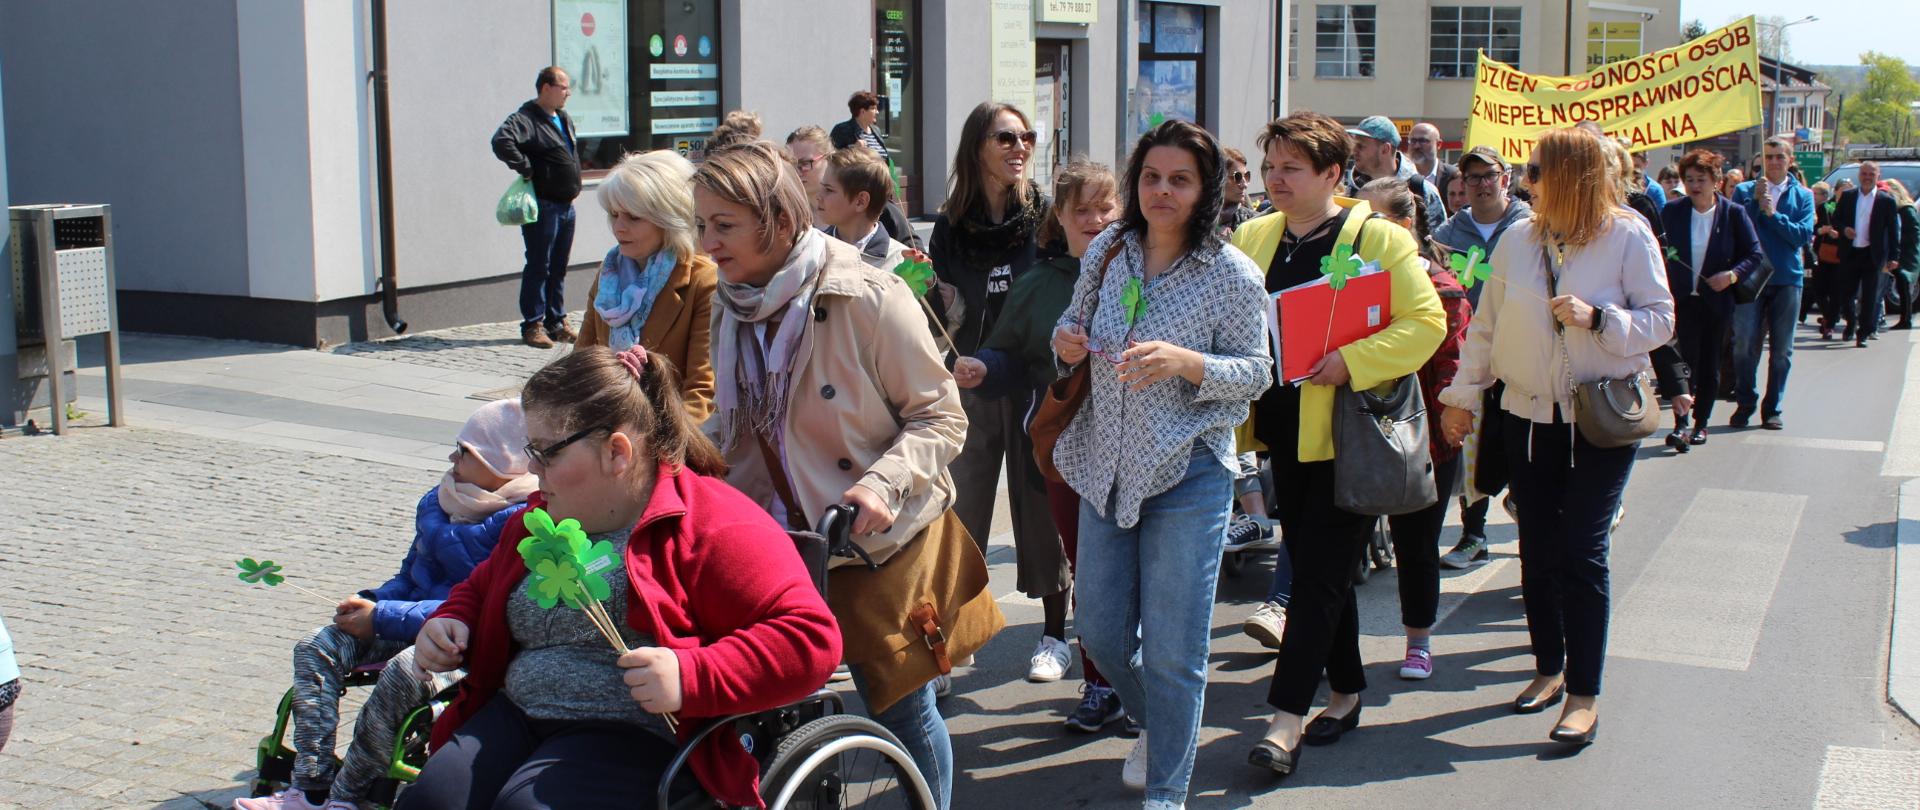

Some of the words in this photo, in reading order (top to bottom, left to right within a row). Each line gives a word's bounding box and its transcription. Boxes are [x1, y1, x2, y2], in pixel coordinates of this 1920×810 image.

[1688, 25, 1751, 61] OSÓB
[1472, 94, 1481, 116] Z
[1484, 62, 1757, 126] NIEPEŁNOSPRAWNOŚCIĄ
